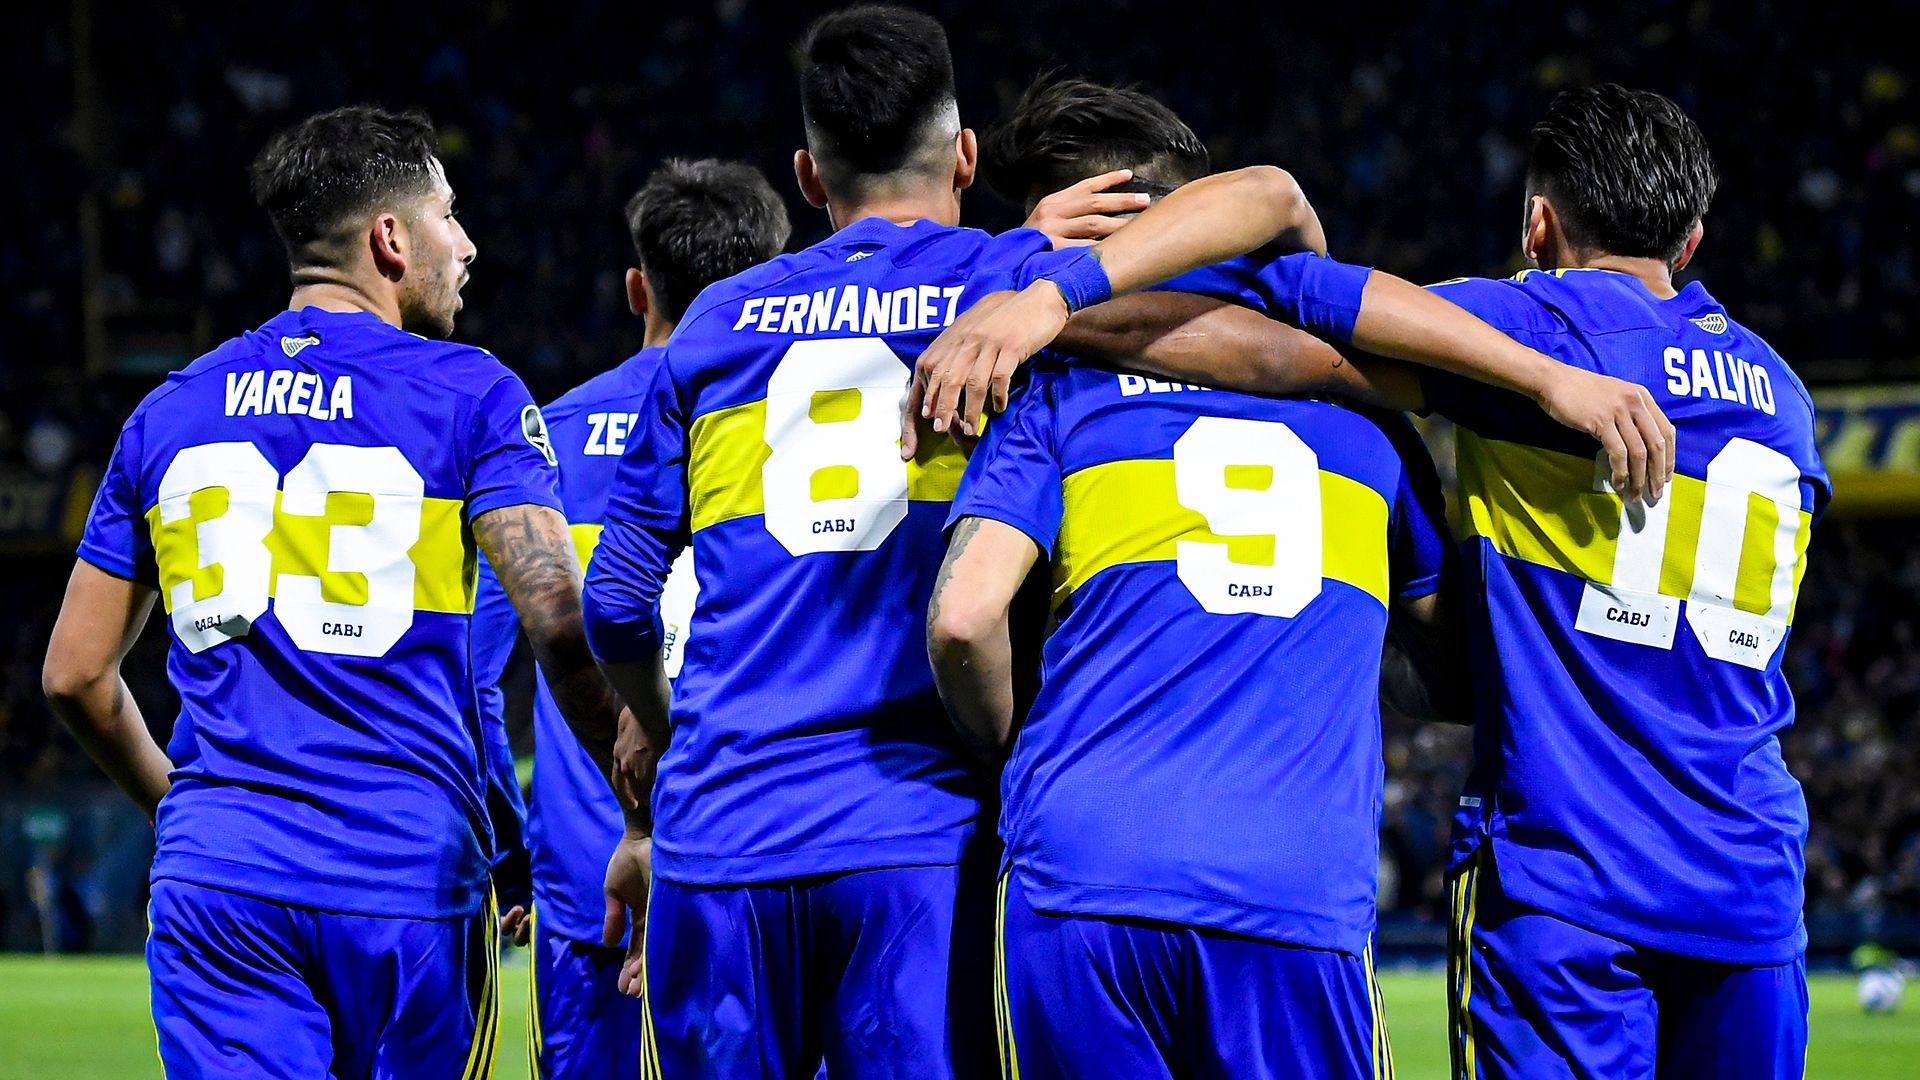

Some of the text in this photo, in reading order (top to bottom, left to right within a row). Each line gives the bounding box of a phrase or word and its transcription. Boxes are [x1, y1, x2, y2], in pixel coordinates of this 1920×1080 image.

[731, 284, 966, 334] FERNANDEZ
[225, 369, 353, 421] VARELA
[1663, 346, 1776, 416] SALVIO
[583, 412, 639, 456] ZE
[762, 336, 912, 557] 8
[811, 518, 856, 535] CABJ
[1173, 415, 1323, 619] 9
[158, 441, 425, 658] 33
[1574, 436, 1802, 672] 10
[1227, 583, 1274, 599] CABJ
[194, 614, 223, 632] CABJ
[322, 622, 363, 638] CABJ
[1606, 607, 1651, 628] CABJ
[1728, 629, 1760, 650] CABJ
